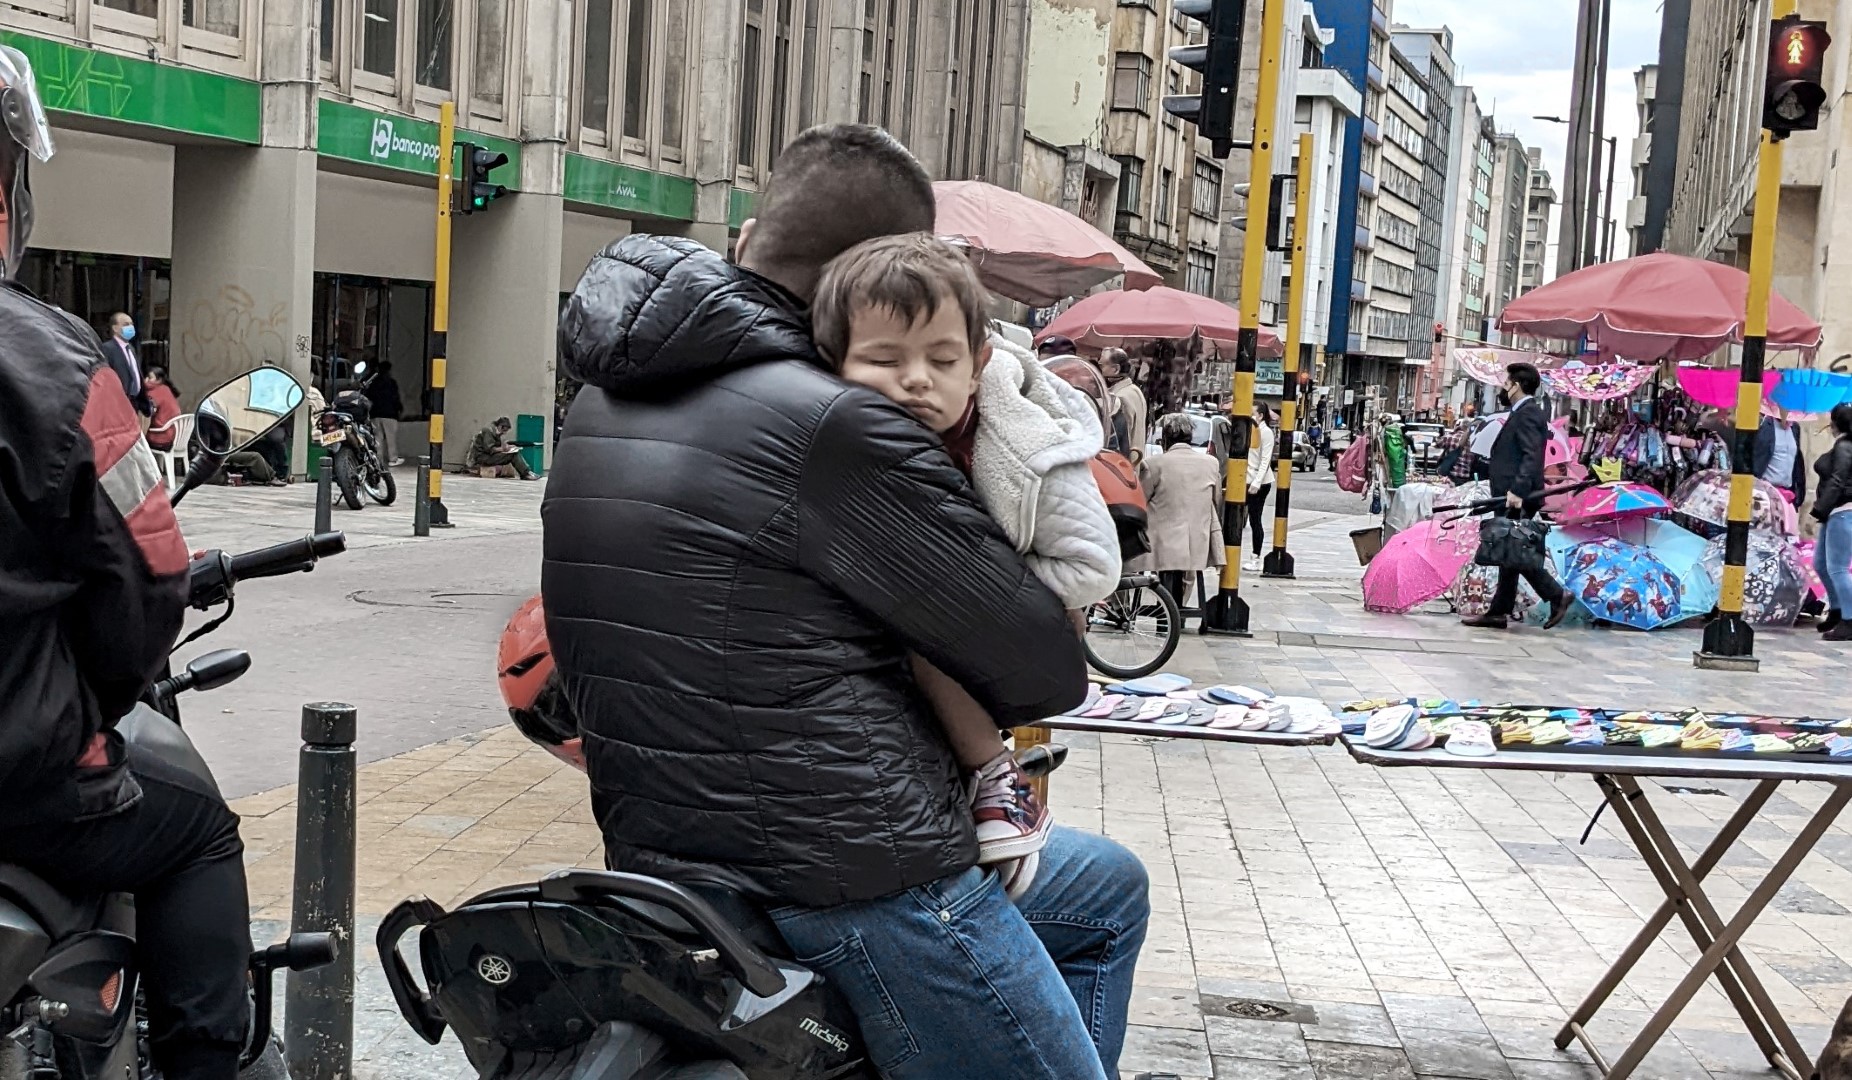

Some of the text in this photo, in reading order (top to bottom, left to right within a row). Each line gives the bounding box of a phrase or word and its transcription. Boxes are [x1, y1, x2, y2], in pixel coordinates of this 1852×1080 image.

[392, 132, 421, 155] banco
[616, 184, 637, 198] AVAL
[799, 1017, 850, 1053] Midship
